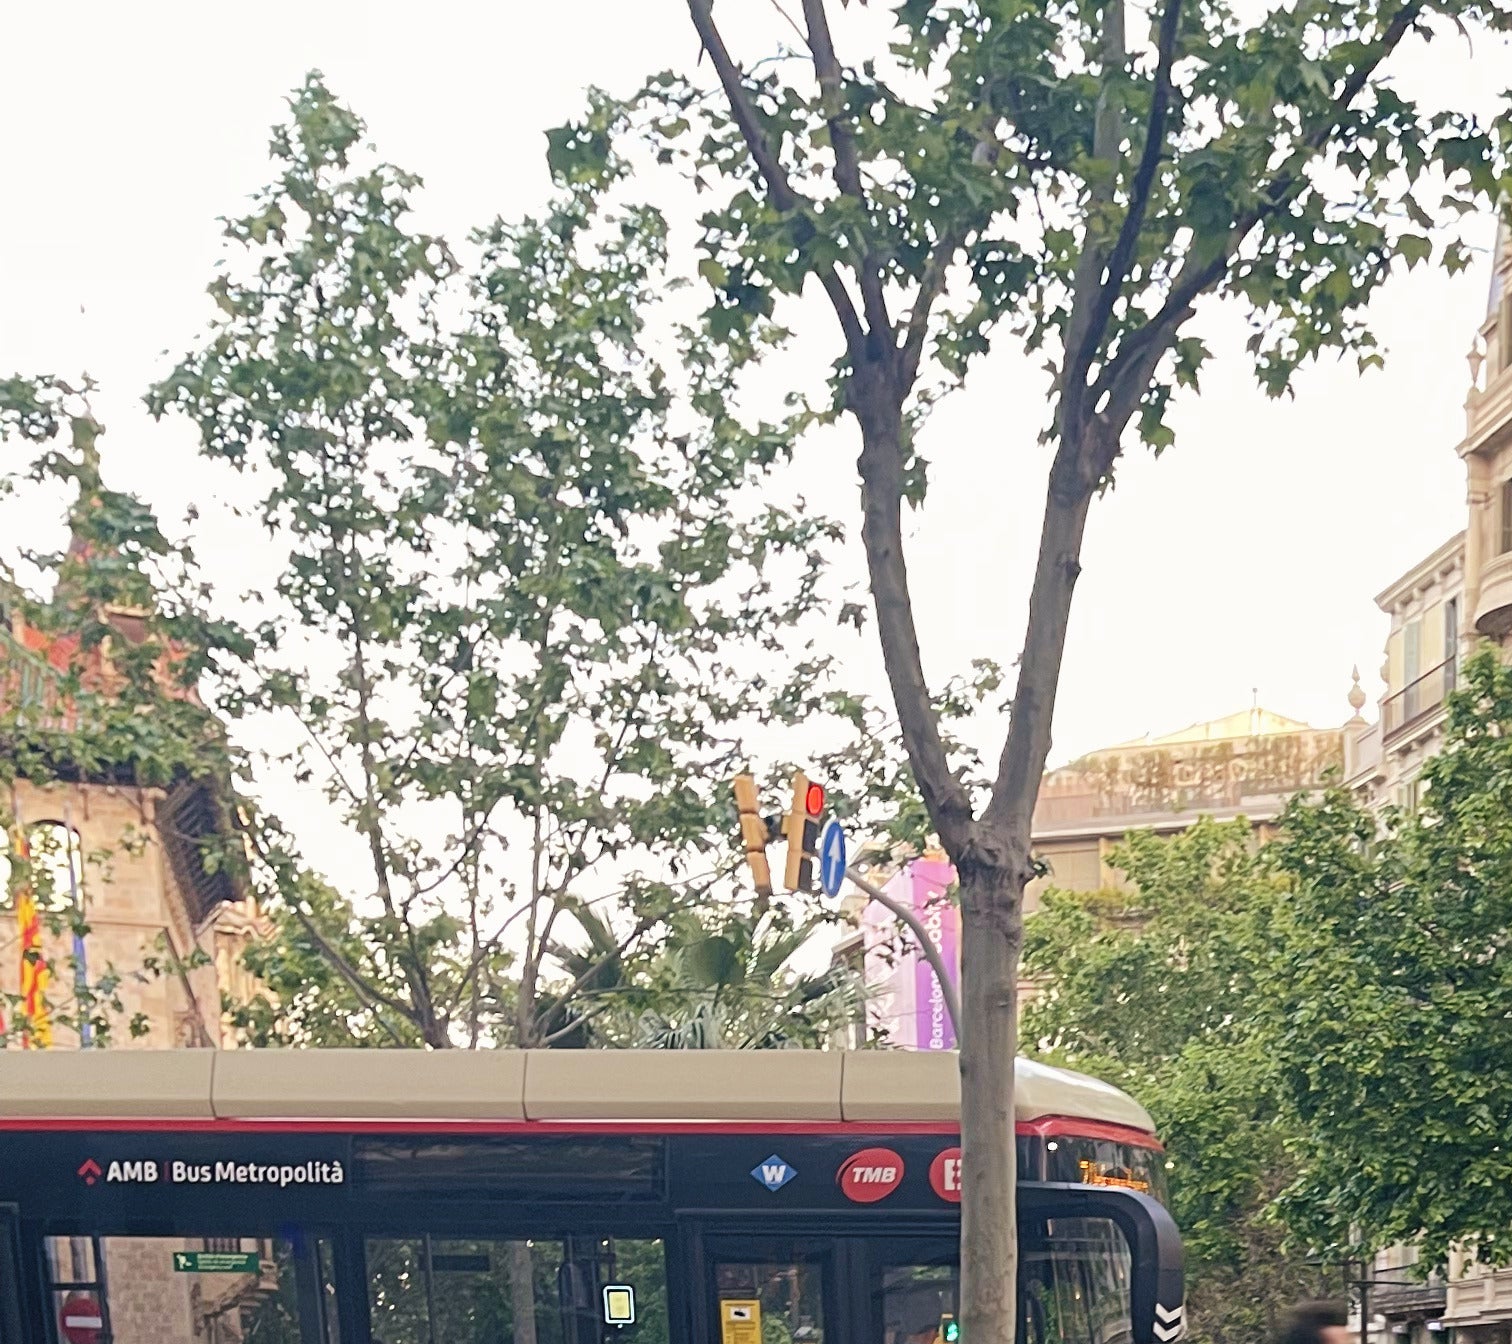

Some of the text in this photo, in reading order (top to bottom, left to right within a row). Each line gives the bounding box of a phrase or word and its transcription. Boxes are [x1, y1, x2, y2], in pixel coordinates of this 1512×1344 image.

[106, 1160, 344, 1188] AMB Bus Metropolità
[762, 1165, 786, 1185] W
[852, 1166, 897, 1184] TMB
